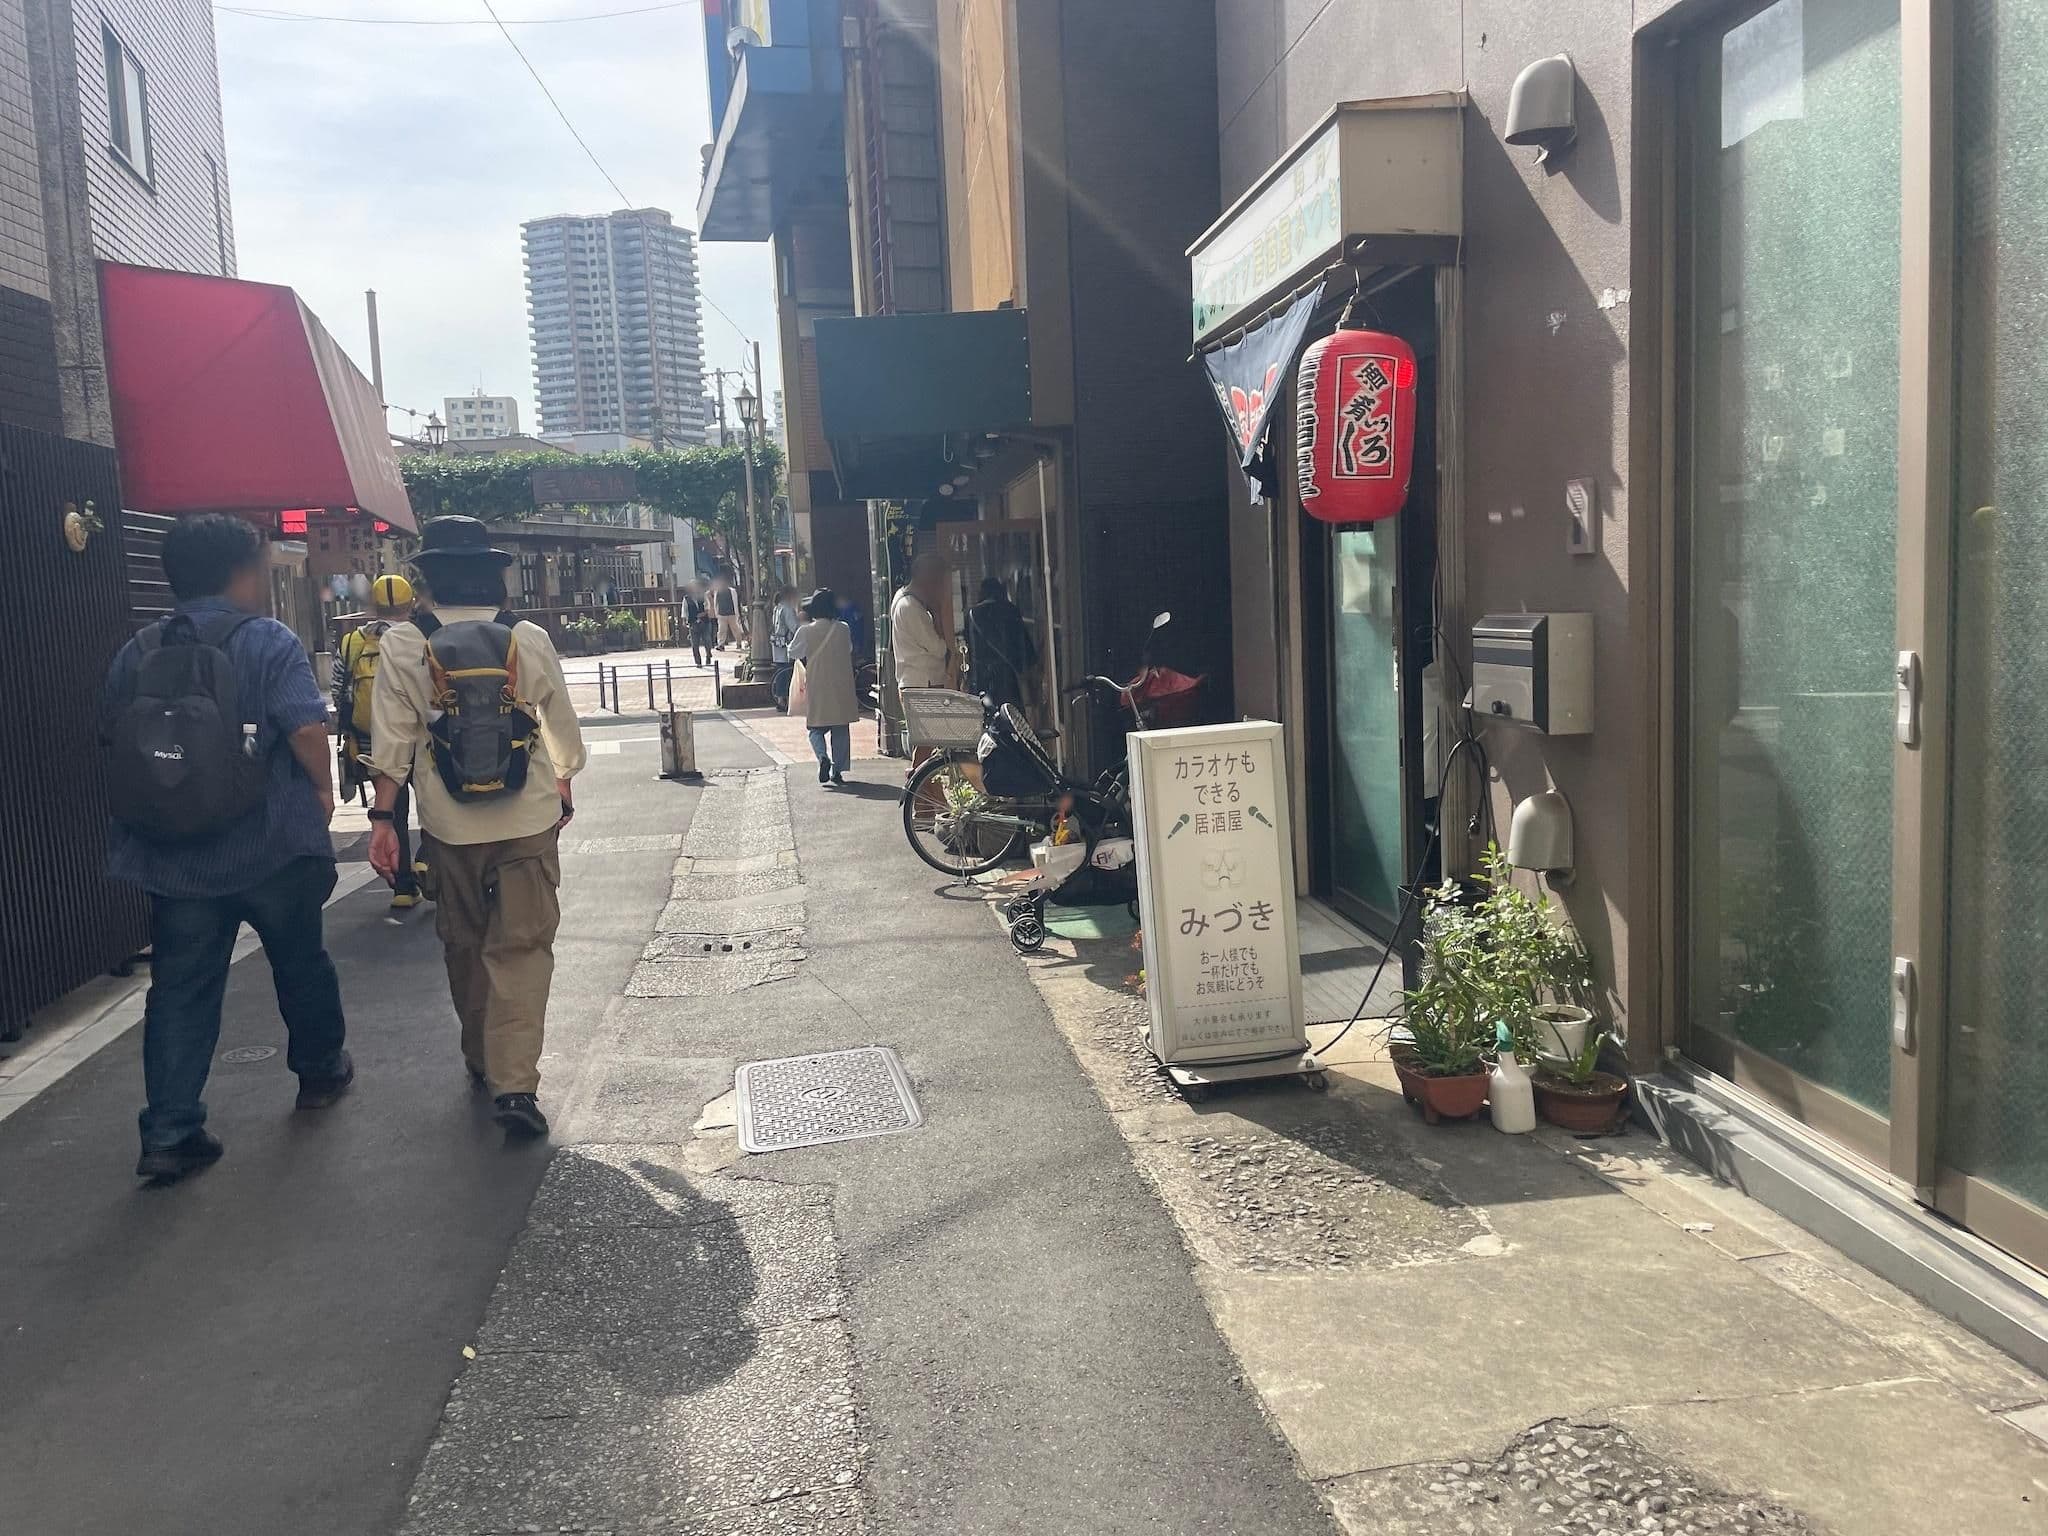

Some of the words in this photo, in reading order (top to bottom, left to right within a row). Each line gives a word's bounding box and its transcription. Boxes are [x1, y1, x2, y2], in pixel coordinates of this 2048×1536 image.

[154, 750, 184, 760] MySQL
[1174, 750, 1255, 779] カラオケも
[1193, 781, 1240, 805] できる
[1194, 810, 1243, 835] 居酒屋
[1180, 900, 1274, 936] みづき
[1200, 945, 1258, 965] お一人様でも
[1201, 961, 1259, 979] 一杯だけでも
[1195, 976, 1265, 995] お気軽にどうぞ
